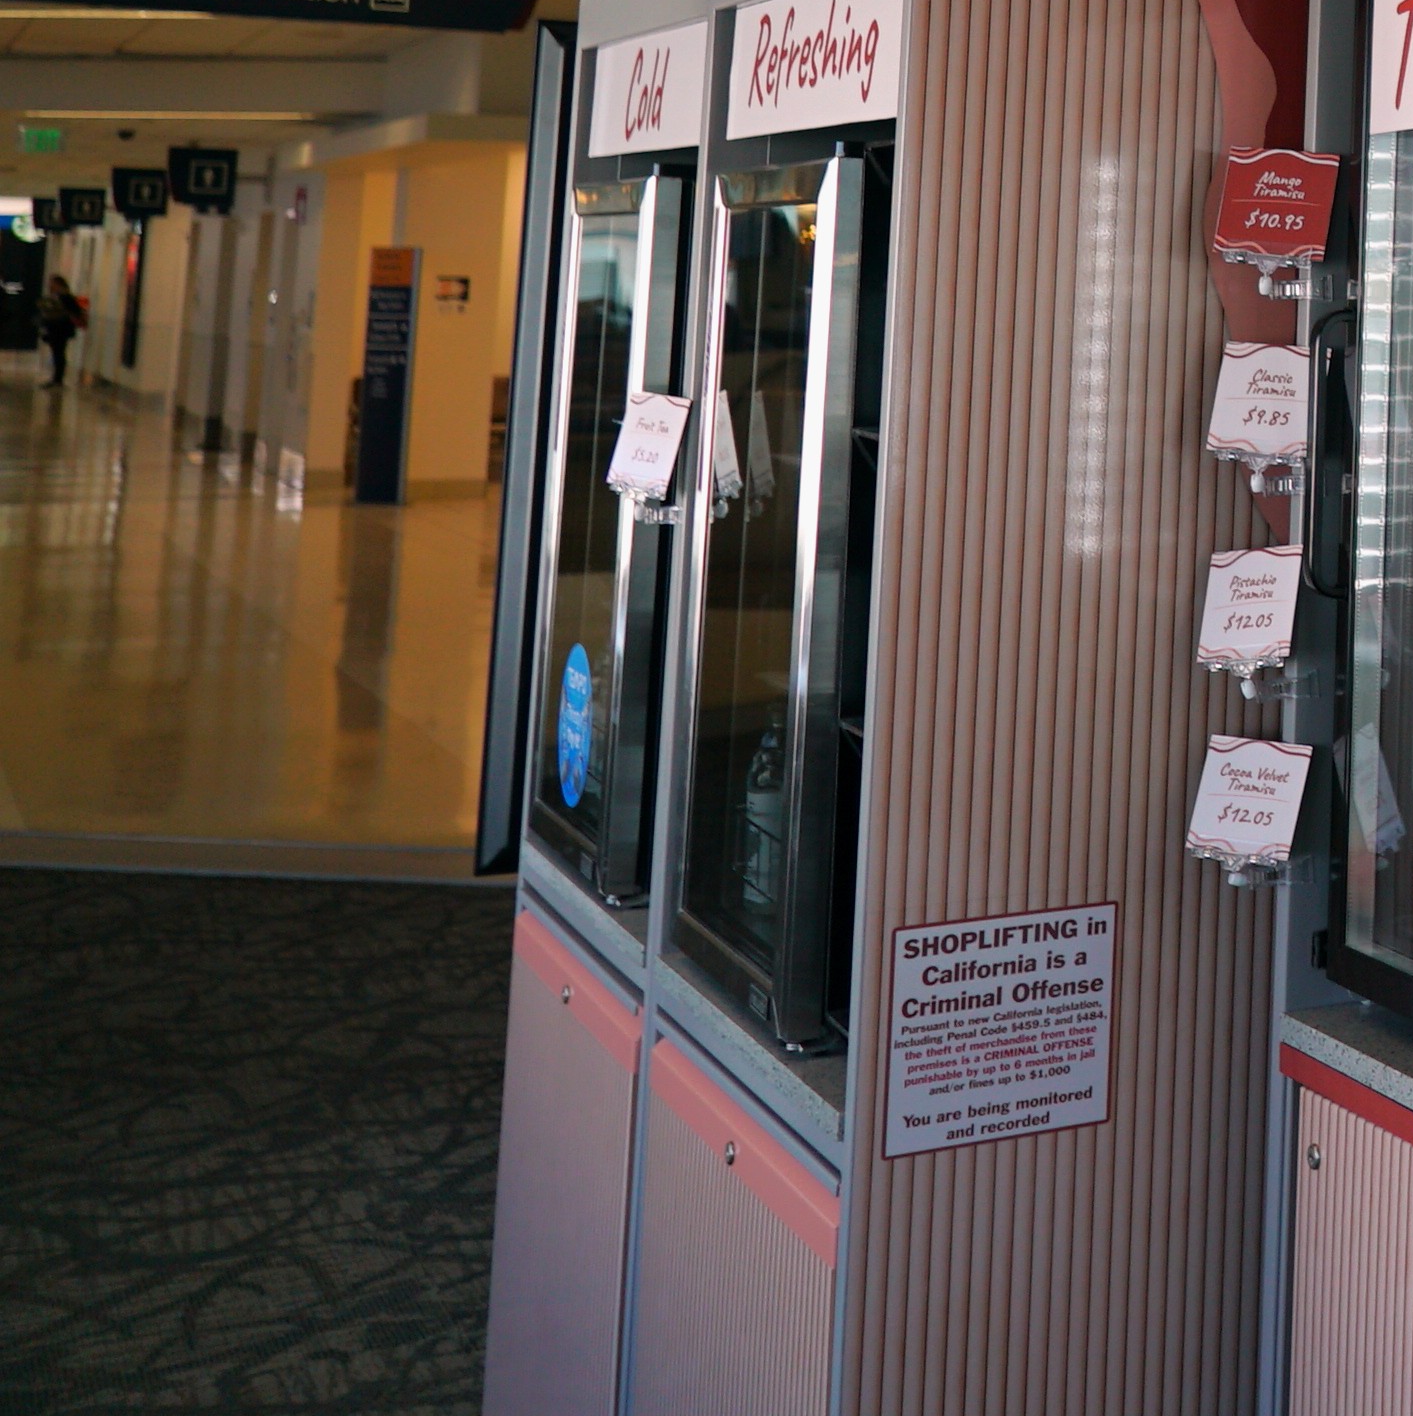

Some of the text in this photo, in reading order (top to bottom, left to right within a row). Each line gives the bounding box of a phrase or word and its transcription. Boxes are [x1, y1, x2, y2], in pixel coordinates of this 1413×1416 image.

[625, 47, 670, 141] Cold
[1253, 183, 1305, 199] Tiramisu
[1259, 171, 1302, 191] Mango
[1245, 208, 1304, 230] $10.95
[1246, 382, 1296, 397] Tiramisu
[1253, 368, 1293, 384] Classic
[1243, 405, 1290, 426] $9.85
[1230, 574, 1277, 589] Pistachio
[1230, 588, 1274, 602] Tiramisu
[1220, 762, 1290, 783] Cocoa Velvet
[1228, 778, 1276, 795] Tiramisu
[903, 915, 1107, 960] SHOPLIFTING in
[921, 949, 1087, 986] California is a
[901, 971, 1104, 1019] Criminal Offense
[893, 1033, 942, 1050] including
[947, 1028, 976, 1041] Penal
[980, 1024, 1007, 1036] Code
[1054, 1014, 1072, 1025] and
[901, 1020, 949, 1036] Pursuant
[954, 1018, 964, 1027] to
[968, 1015, 988, 1025] new
[993, 1006, 1042, 1022] California
[904, 1024, 1096, 1061] the theft of merchandise from these
[907, 1057, 957, 1074] premises
[961, 1055, 970, 1064] is
[984, 1044, 1039, 1061] CRIMINAL
[1043, 1036, 1093, 1052] OFFENSE
[903, 1048, 1094, 1088] punishable by up to 6 months in jail
[968, 1076, 994, 1089] fines
[998, 1075, 1011, 1085] up
[1015, 1072, 1025, 1081] to
[1030, 1063, 1070, 1080] $1,000
[902, 1085, 1092, 1129] You are being monitored
[946, 1110, 1049, 1140] and recorded
